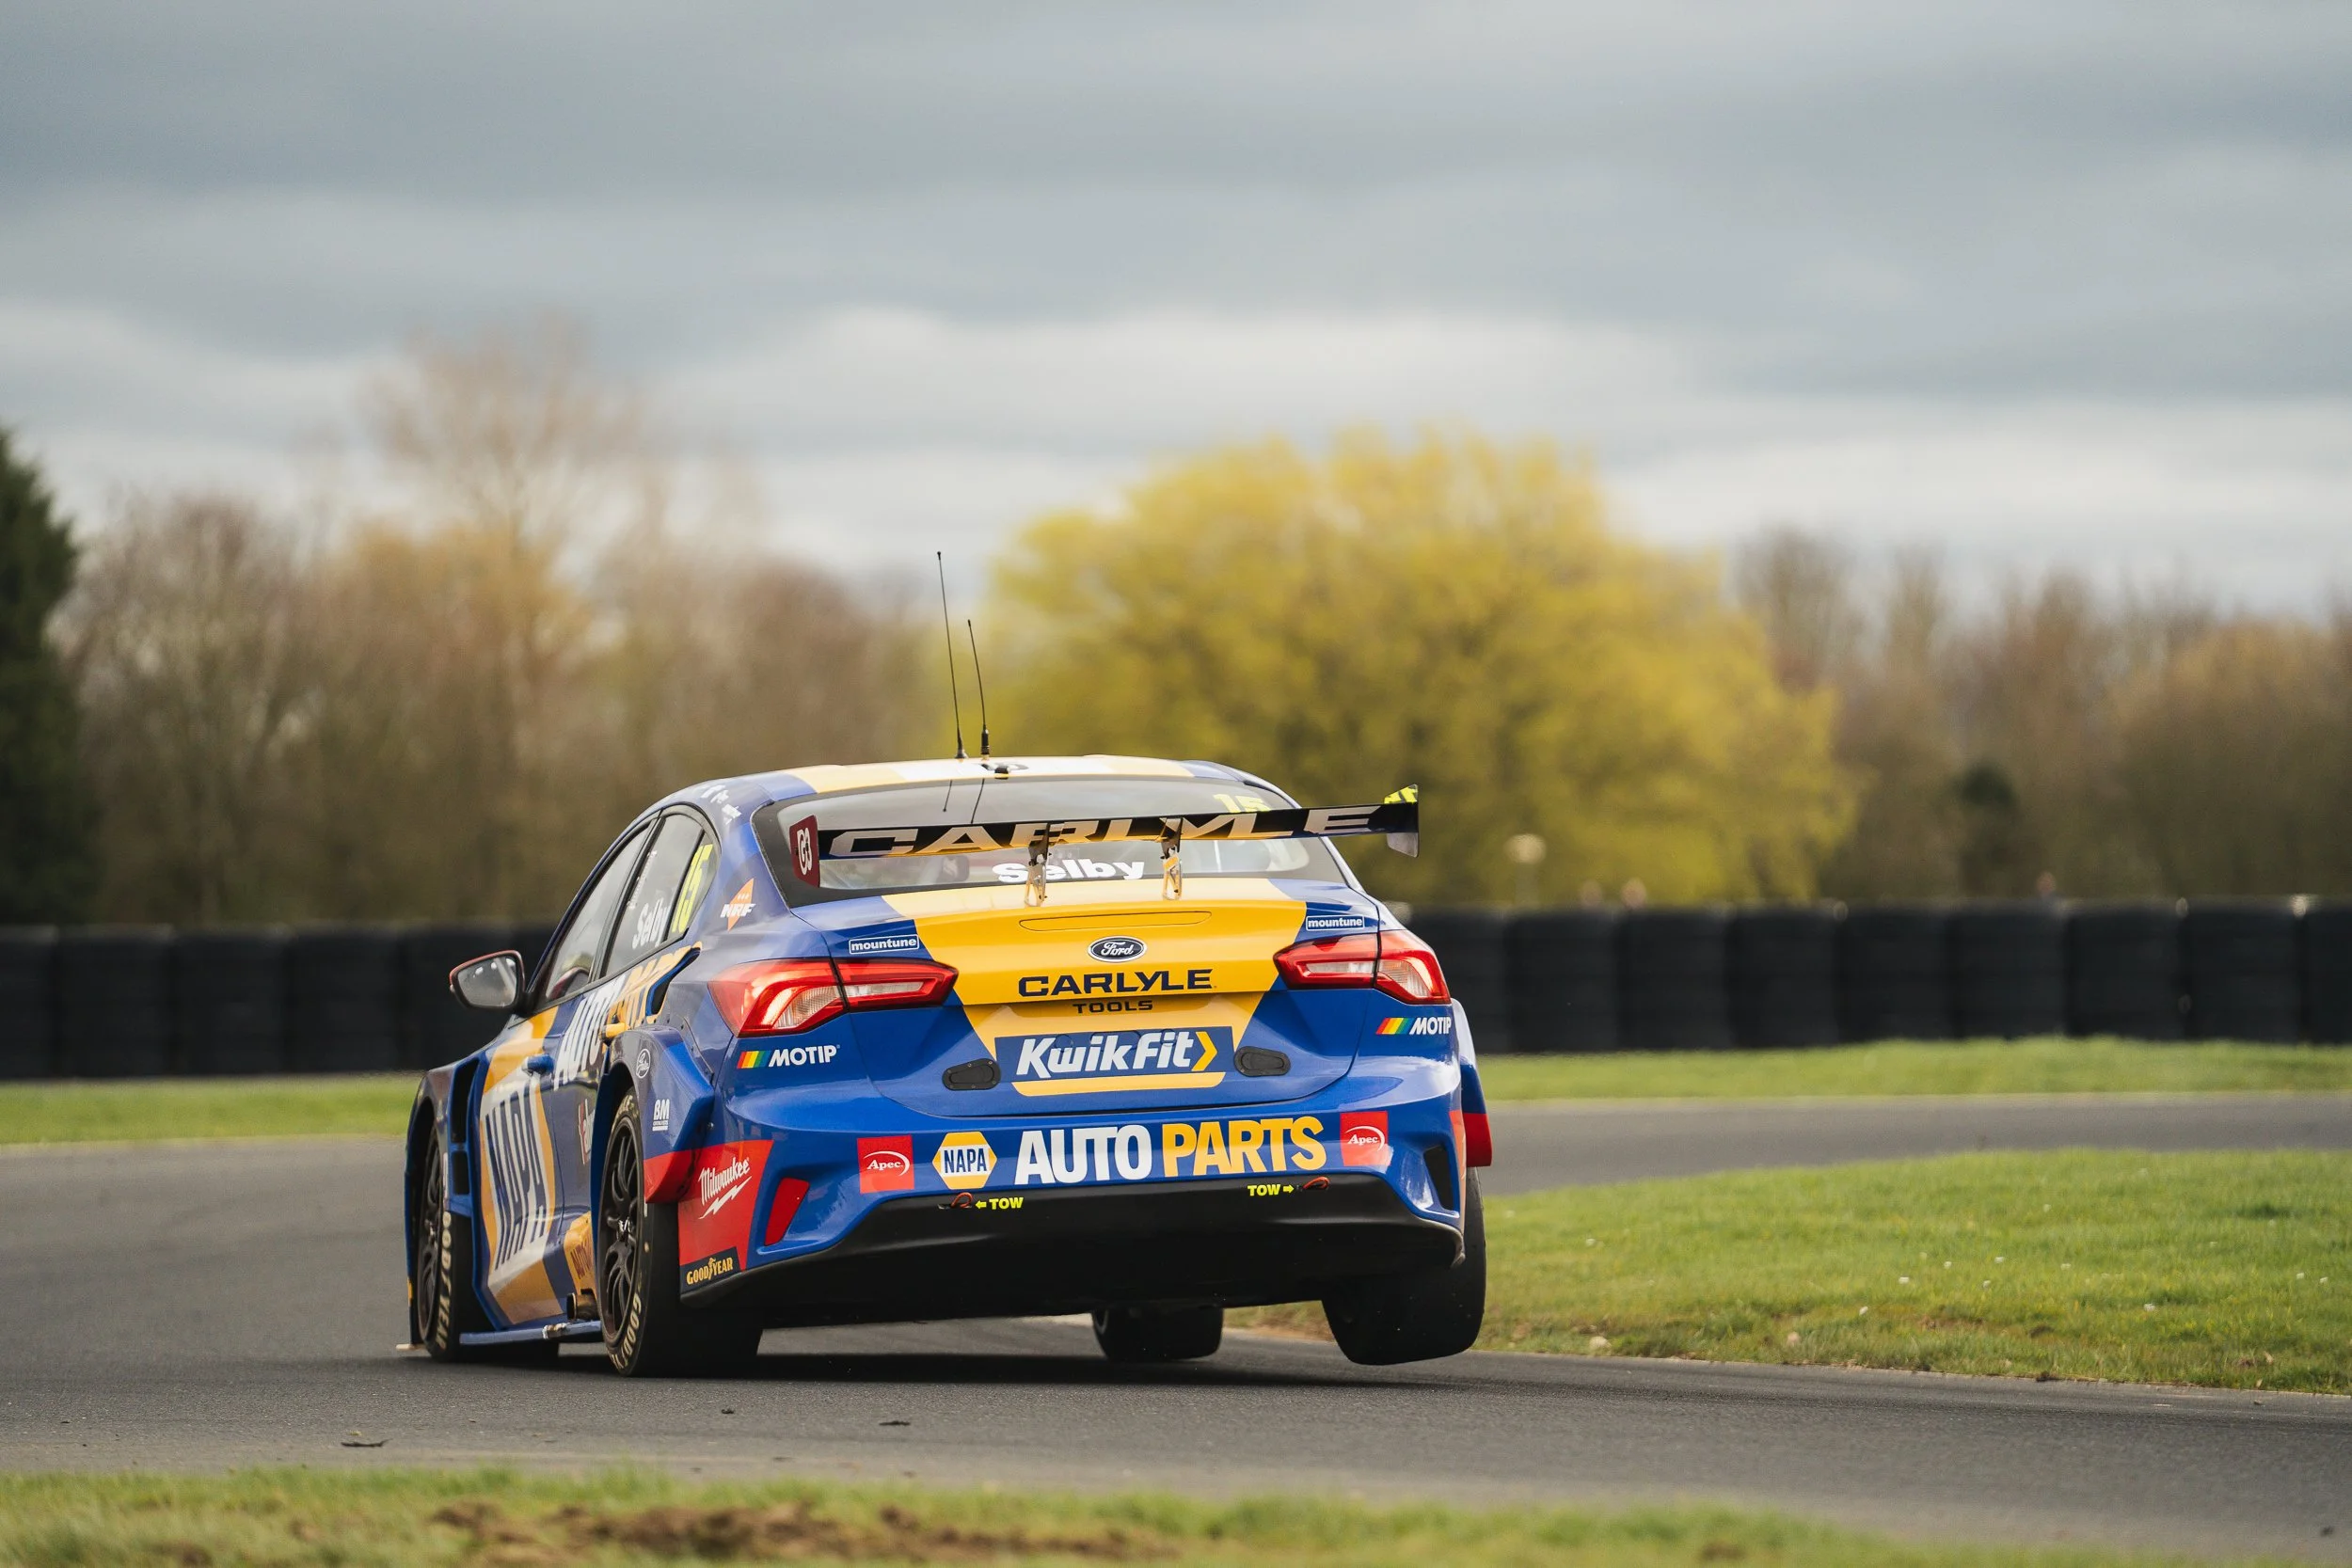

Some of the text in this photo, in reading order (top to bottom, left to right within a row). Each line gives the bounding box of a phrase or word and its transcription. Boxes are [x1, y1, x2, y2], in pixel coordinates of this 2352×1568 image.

[1212, 793, 1272, 814] 15
[829, 805, 1381, 857] CARLYLE
[992, 858, 1145, 883] Selby
[720, 902, 756, 919] NRF
[1308, 916, 1363, 929] mountune
[850, 937, 917, 952] mountune
[1100, 940, 1135, 958] Ford
[1018, 968, 1215, 998] CARLYLE
[1073, 1000, 1153, 1015] TOOLS
[1409, 1016, 1453, 1036] MOTIP
[768, 1044, 837, 1068] MOTIP
[653, 1098, 671, 1121] BM
[1347, 1133, 1380, 1147] Apec
[944, 1116, 1327, 1185] NAPA AUTO PARTS
[866, 1158, 902, 1171] Apec
[485, 1084, 548, 1271] NAPA
[698, 1157, 751, 1207] Milwaukee
[1247, 1183, 1281, 1196] TOW
[988, 1196, 1025, 1210] TOW
